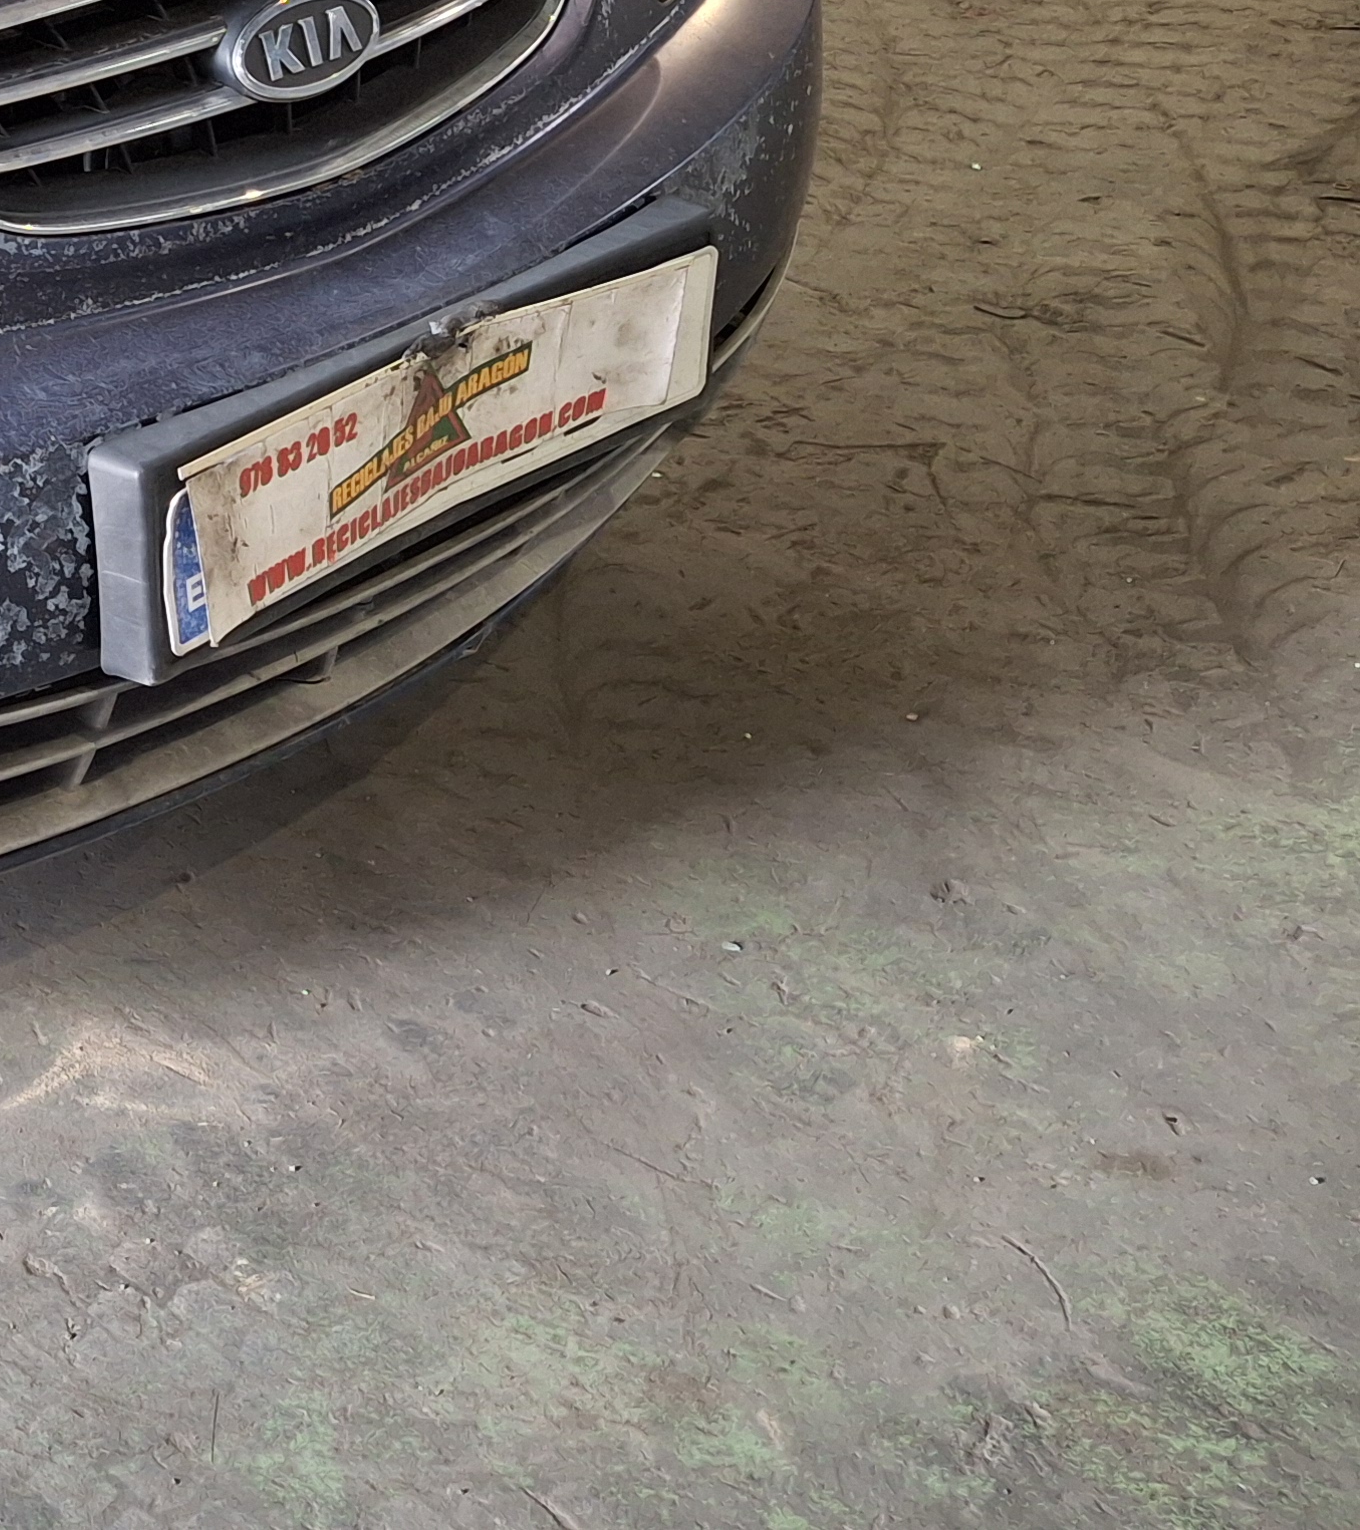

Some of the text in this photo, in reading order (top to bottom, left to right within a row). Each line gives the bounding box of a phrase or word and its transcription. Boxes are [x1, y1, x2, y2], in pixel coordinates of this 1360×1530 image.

[258, 5, 363, 82] KIA
[276, 440, 303, 478] 83
[333, 412, 358, 448] 52
[331, 424, 414, 514] RECICLAJES
[455, 347, 530, 407] ARAGÓN
[186, 572, 207, 613] E
